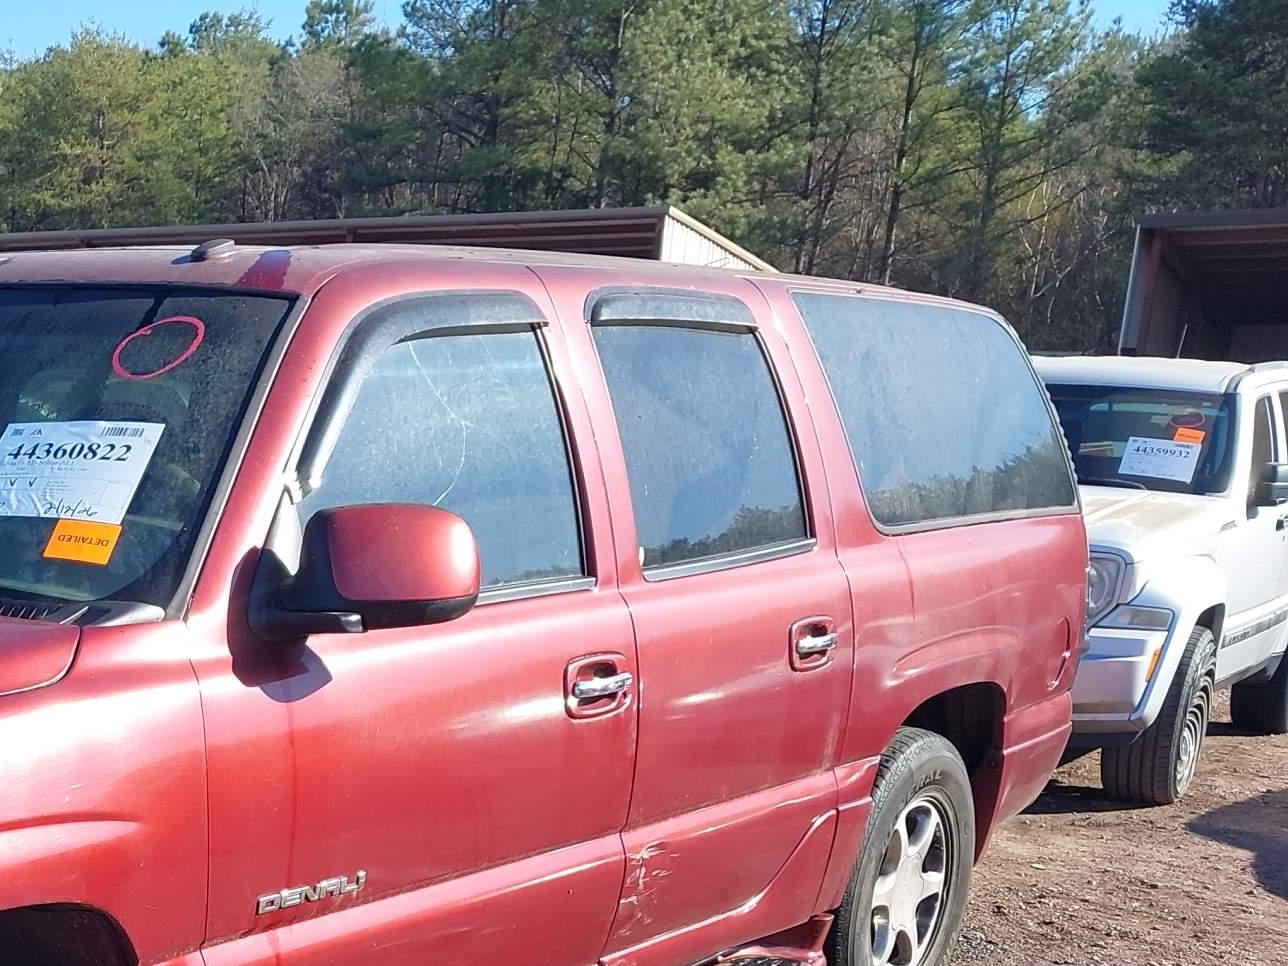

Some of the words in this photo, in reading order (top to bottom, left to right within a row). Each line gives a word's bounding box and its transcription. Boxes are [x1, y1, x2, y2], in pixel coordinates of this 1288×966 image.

[8, 442, 132, 461] 44360822
[1133, 445, 1191, 458] 44359932
[57, 534, 110, 547] DETAILED
[256, 869, 367, 915] DENALI
